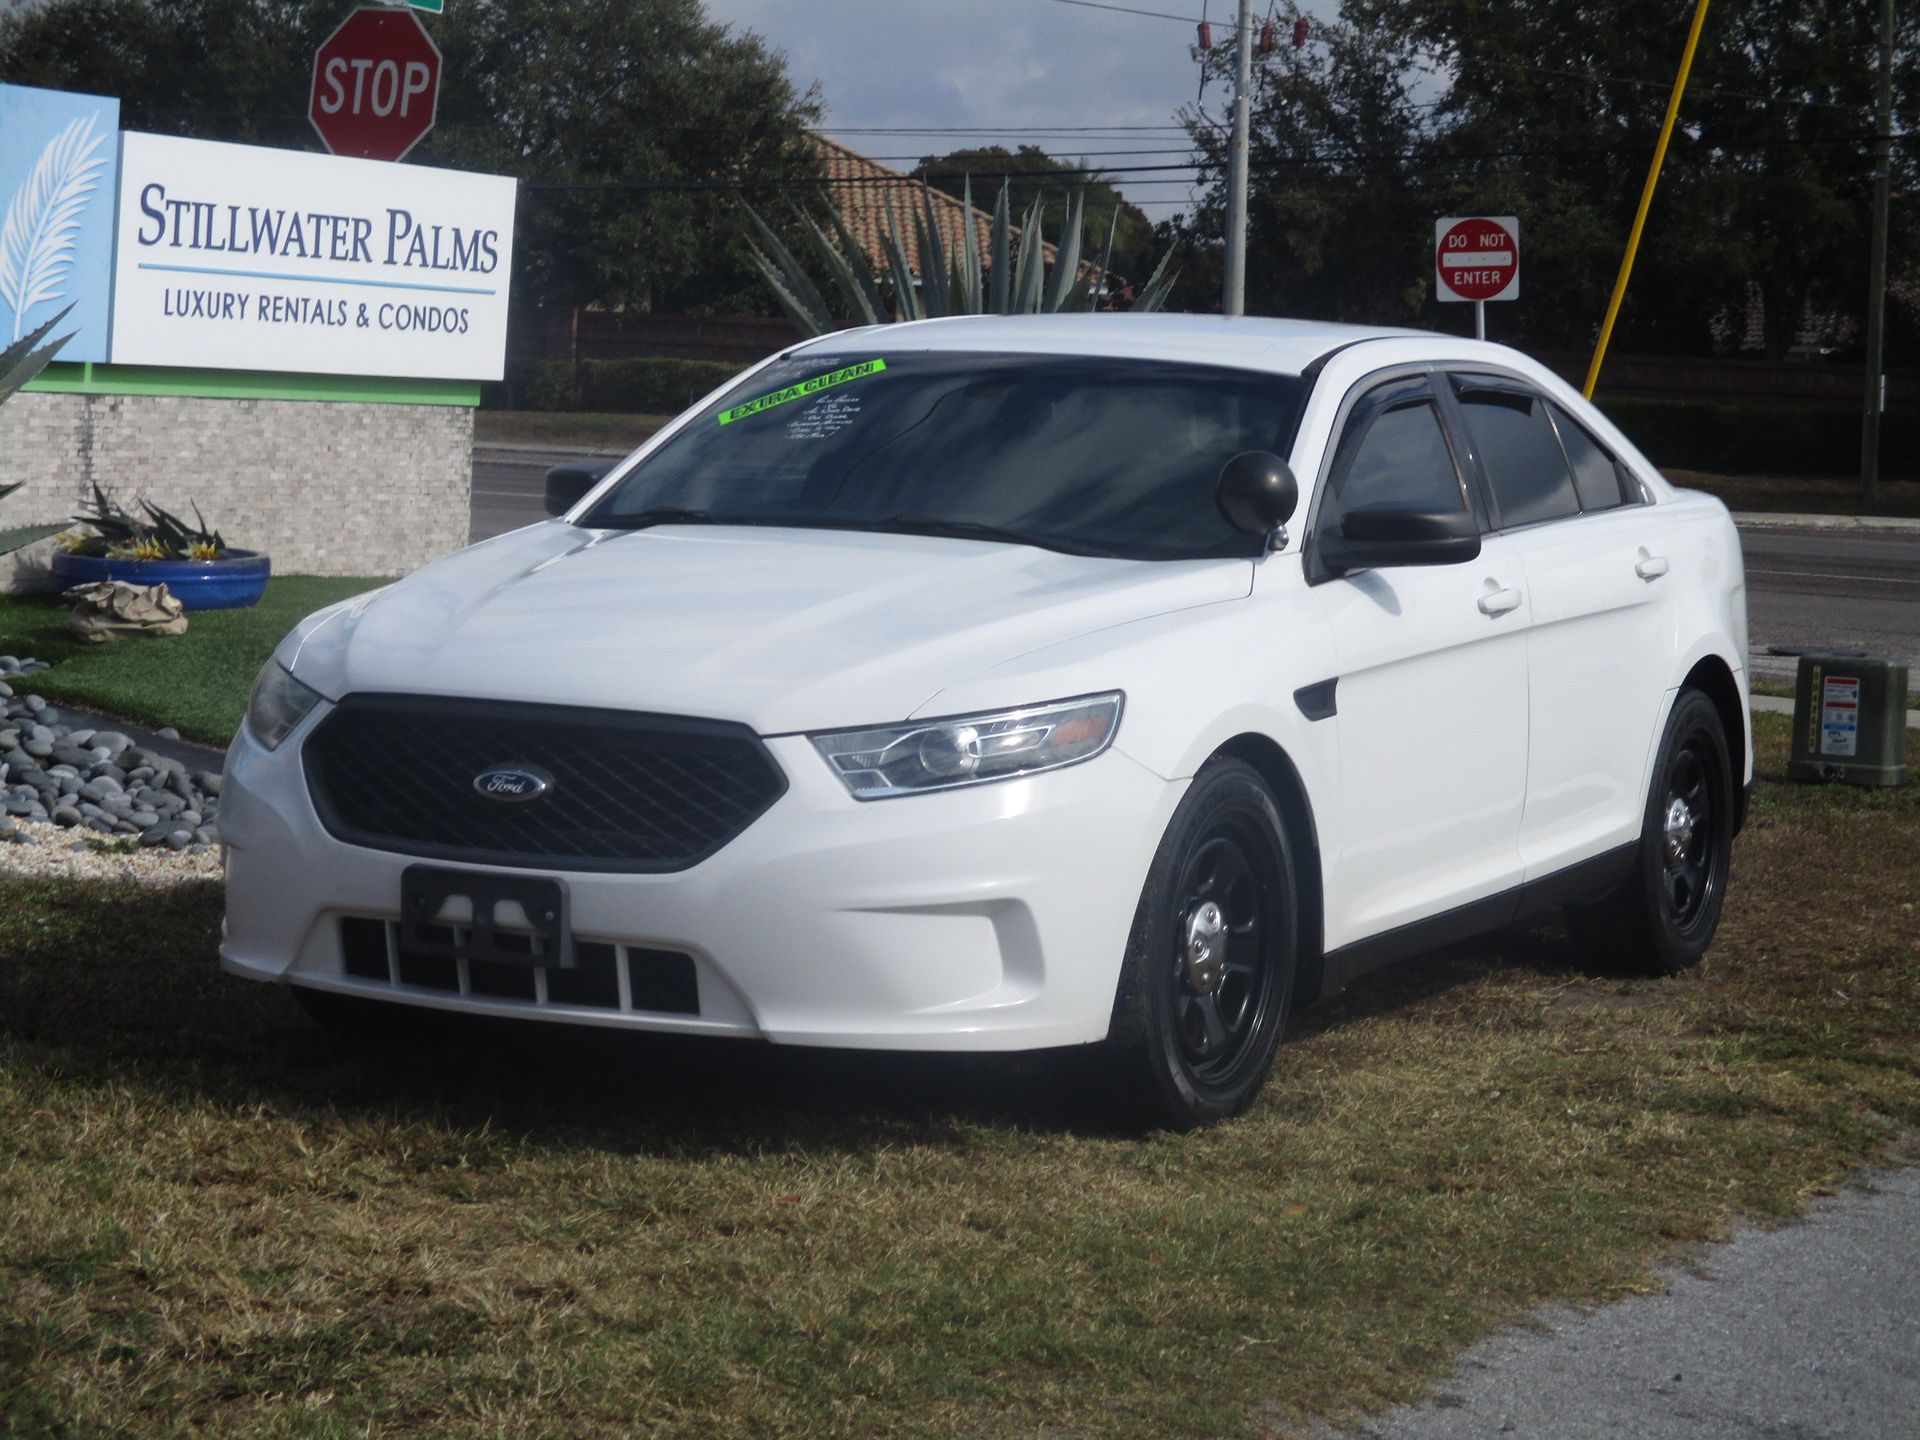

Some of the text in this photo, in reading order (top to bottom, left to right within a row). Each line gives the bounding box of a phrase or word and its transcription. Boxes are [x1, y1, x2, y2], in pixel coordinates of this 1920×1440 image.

[320, 57, 430, 118] STOP
[138, 183, 498, 274] STILLWATER PALMS
[1448, 233, 1506, 248] DO NOT
[1454, 271, 1501, 285] ENTER
[163, 288, 469, 334] LUXURY RENTALS & CONDOS
[730, 387, 800, 419] EXTRA
[486, 774, 526, 794] Ford
